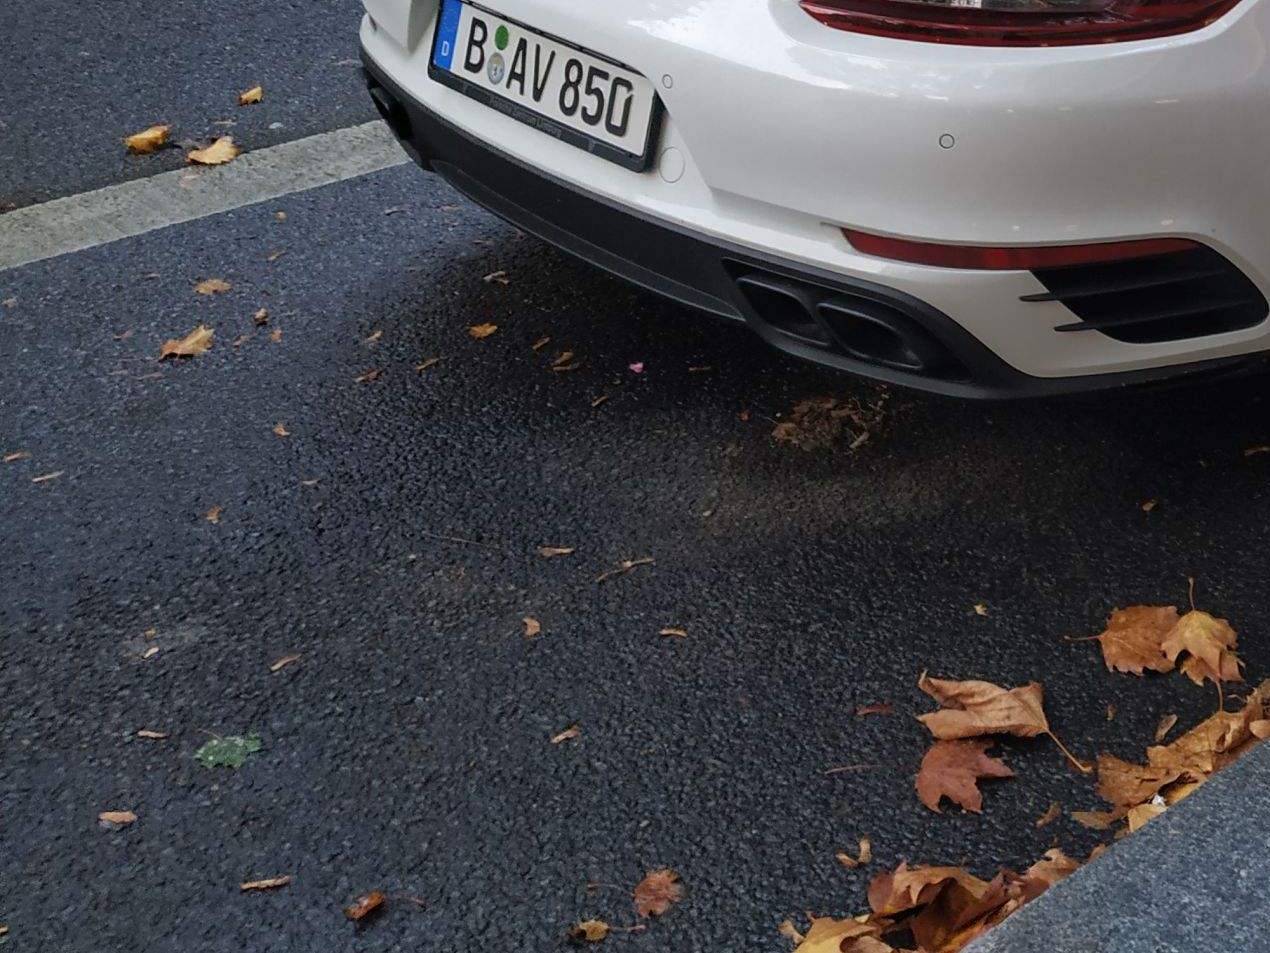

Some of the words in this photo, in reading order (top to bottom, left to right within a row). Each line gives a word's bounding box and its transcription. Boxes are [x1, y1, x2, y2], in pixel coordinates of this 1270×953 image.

[463, 16, 488, 74] B
[505, 37, 556, 103] AV
[558, 57, 635, 138] 850
